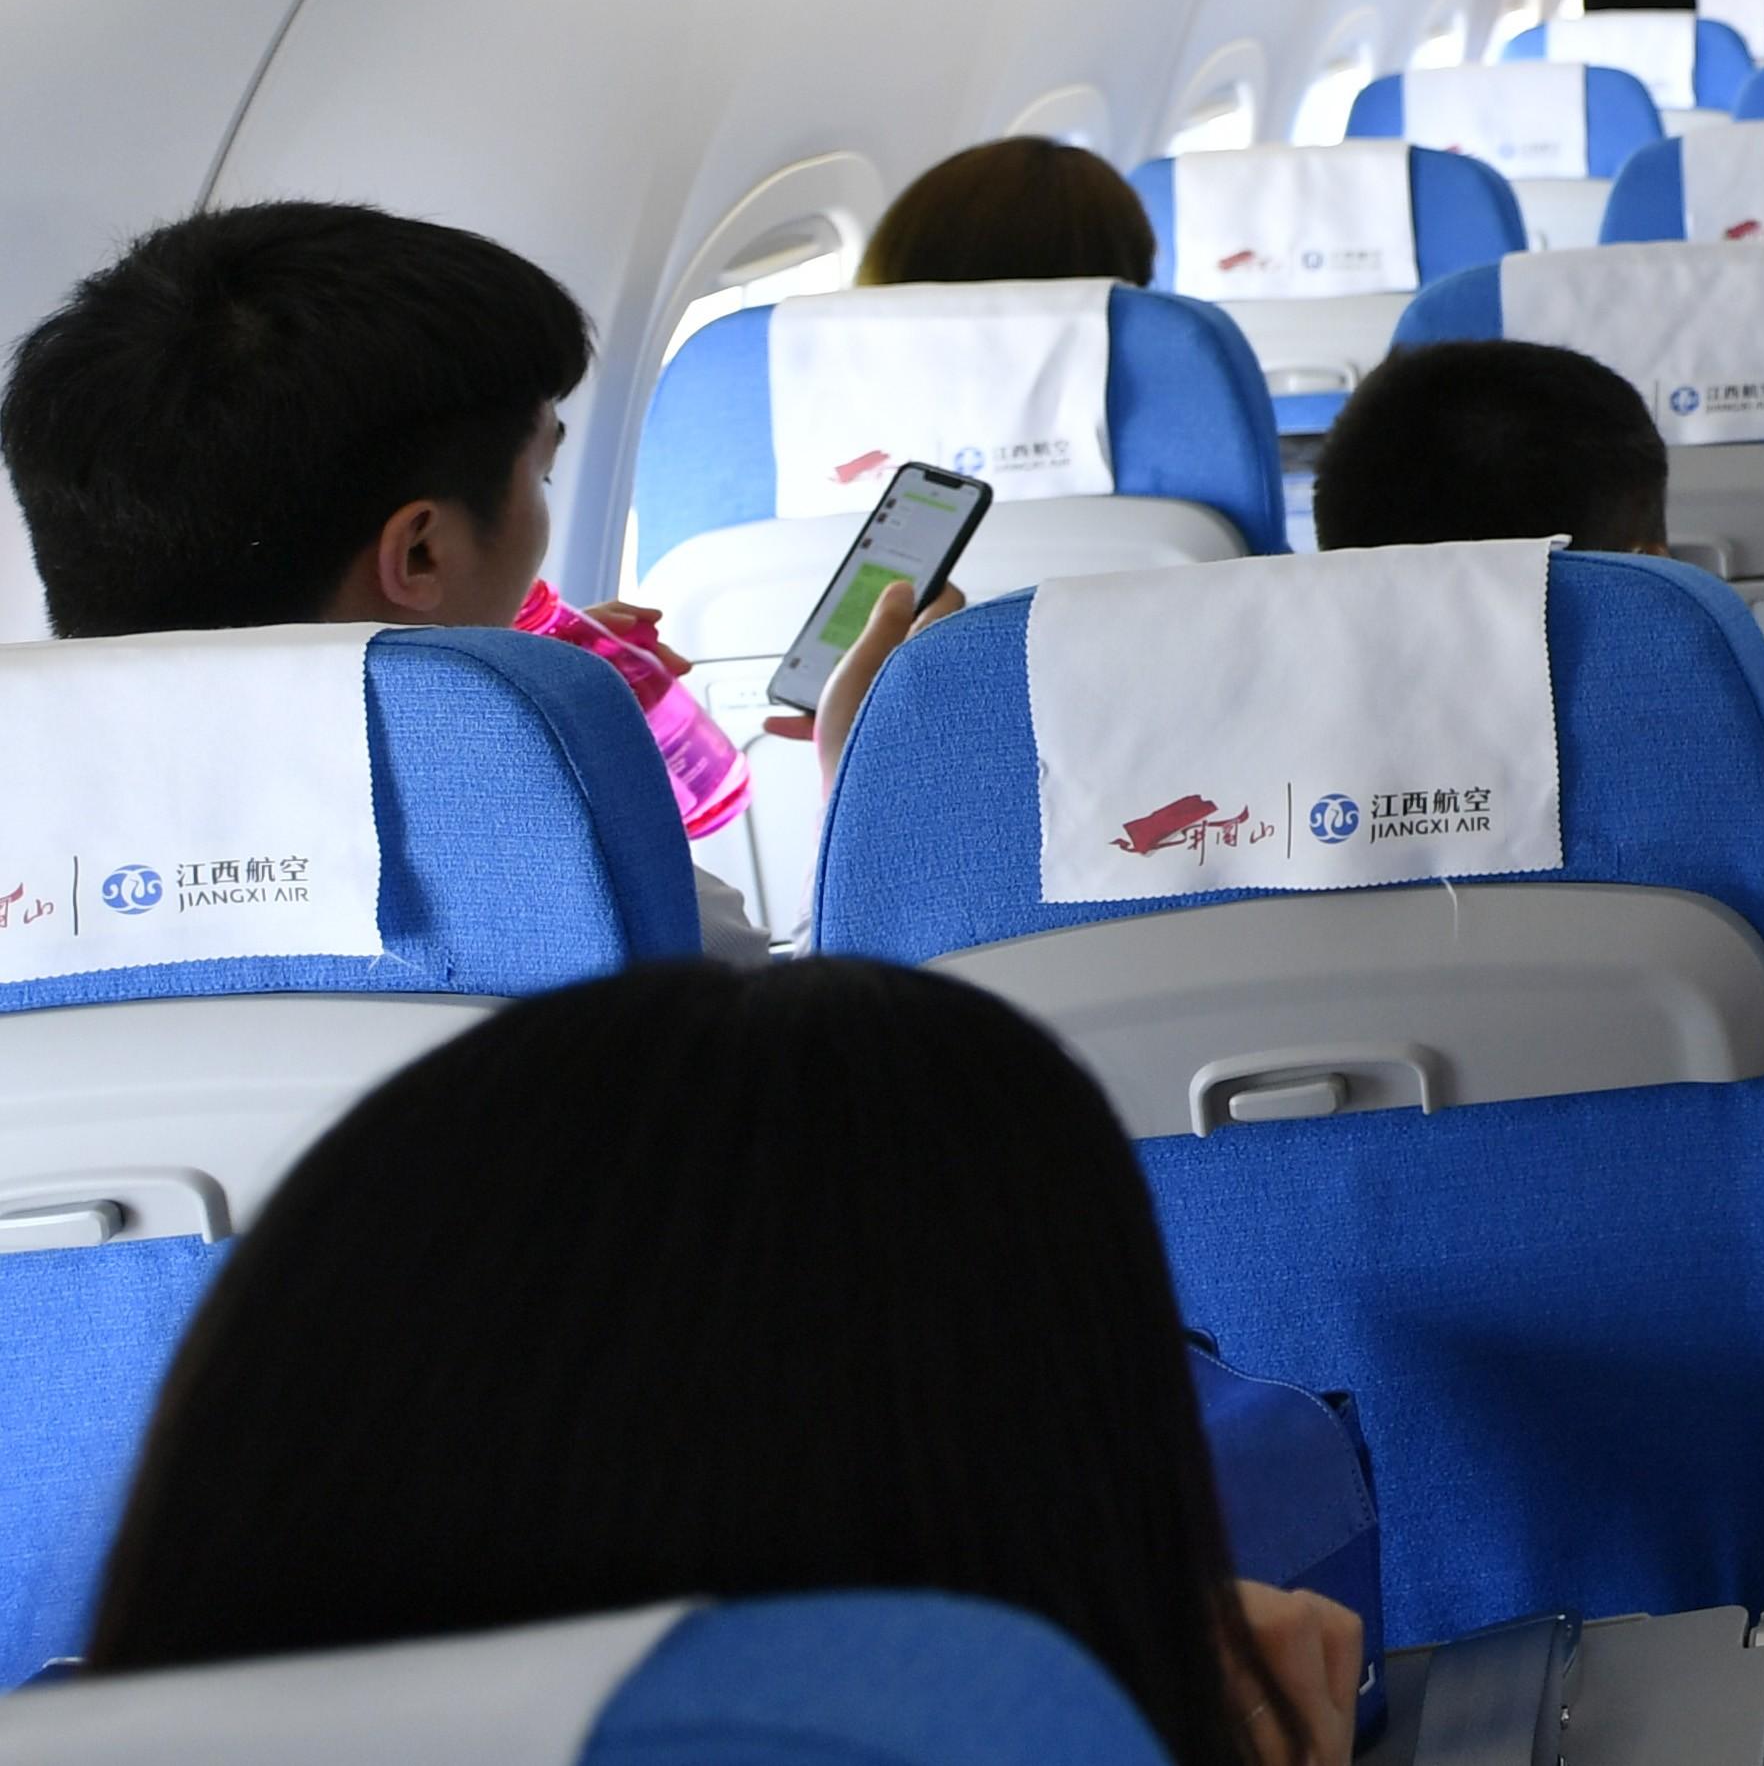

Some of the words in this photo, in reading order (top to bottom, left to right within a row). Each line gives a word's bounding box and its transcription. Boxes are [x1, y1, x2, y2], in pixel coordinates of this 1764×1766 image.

[1370, 786, 1492, 820] 江西航空
[1370, 819, 1449, 844] JIANGXI
[1456, 816, 1491, 832] AIR
[176, 854, 310, 888] 江西航空
[178, 887, 267, 913] JIANGXI
[274, 886, 310, 903] AIR
